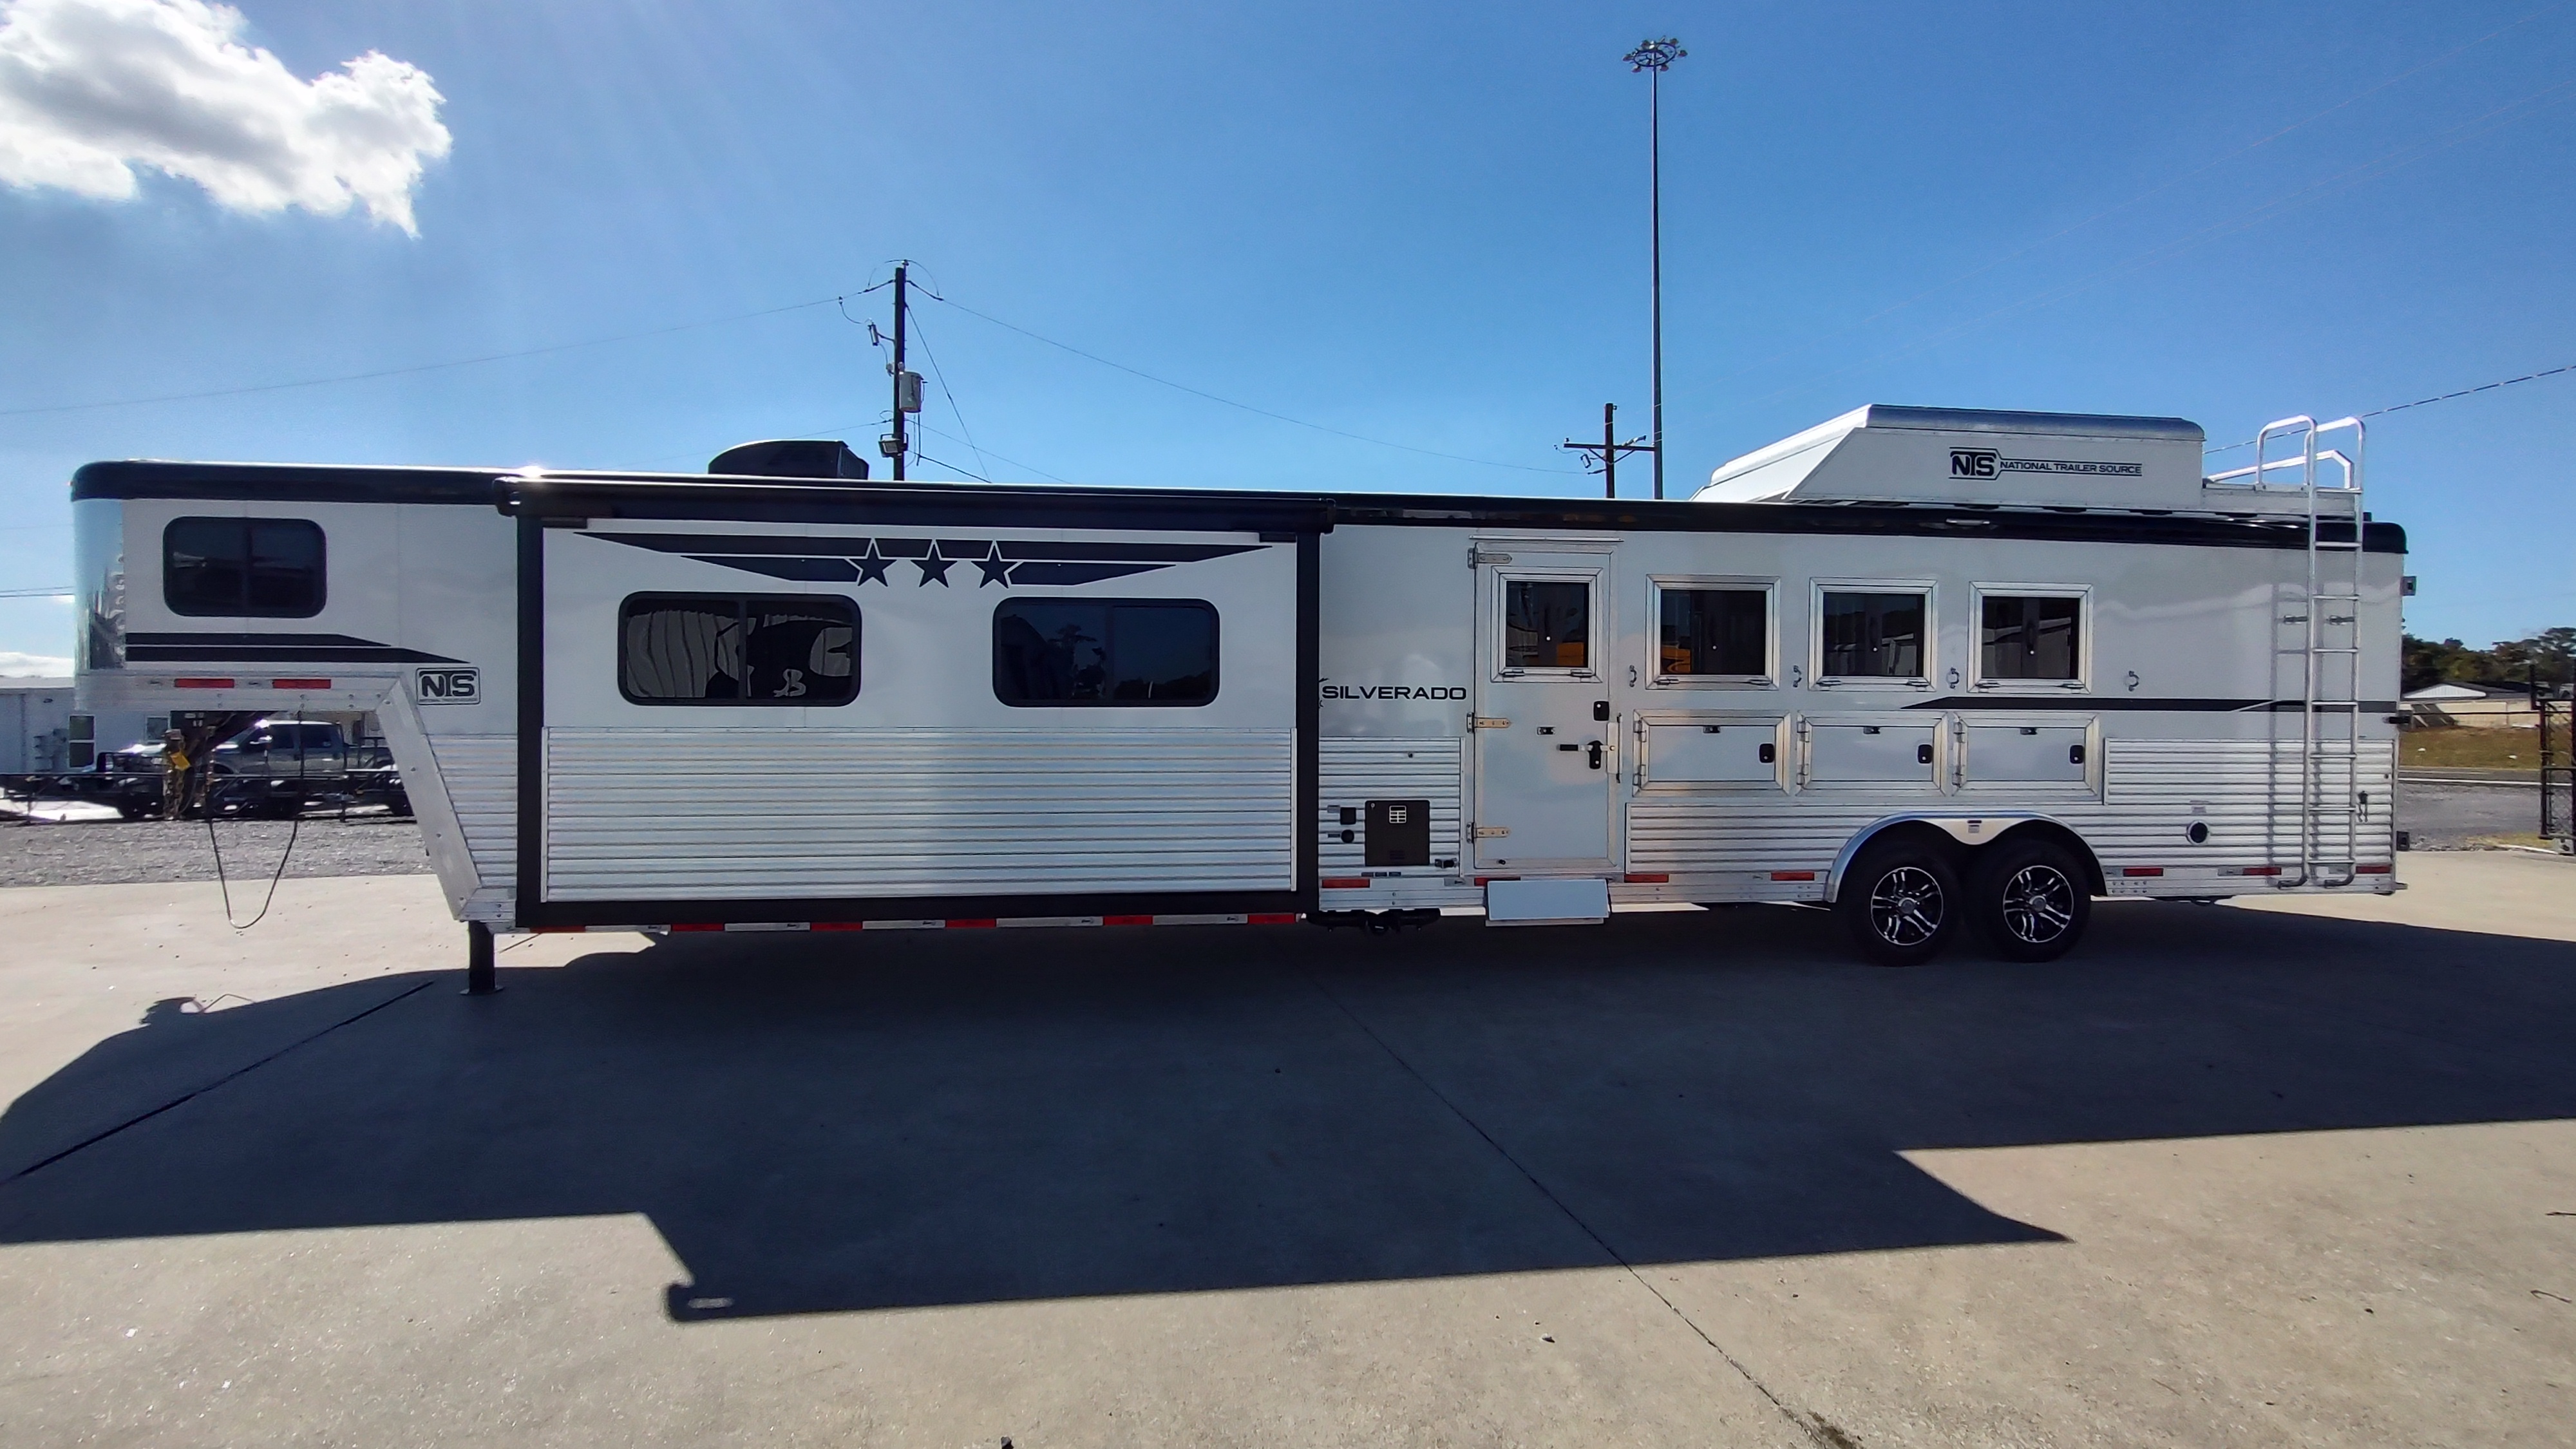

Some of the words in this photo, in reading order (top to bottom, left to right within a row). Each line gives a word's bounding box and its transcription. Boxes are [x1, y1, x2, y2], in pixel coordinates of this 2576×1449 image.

[1950, 451, 1996, 476] NTS
[2000, 461, 2052, 470] NATIONAL
[2053, 463, 2098, 472] TRAILER
[2098, 465, 2142, 473] SOURCE
[419, 670, 477, 697] NTS
[1322, 686, 1466, 700] SILVERADO
